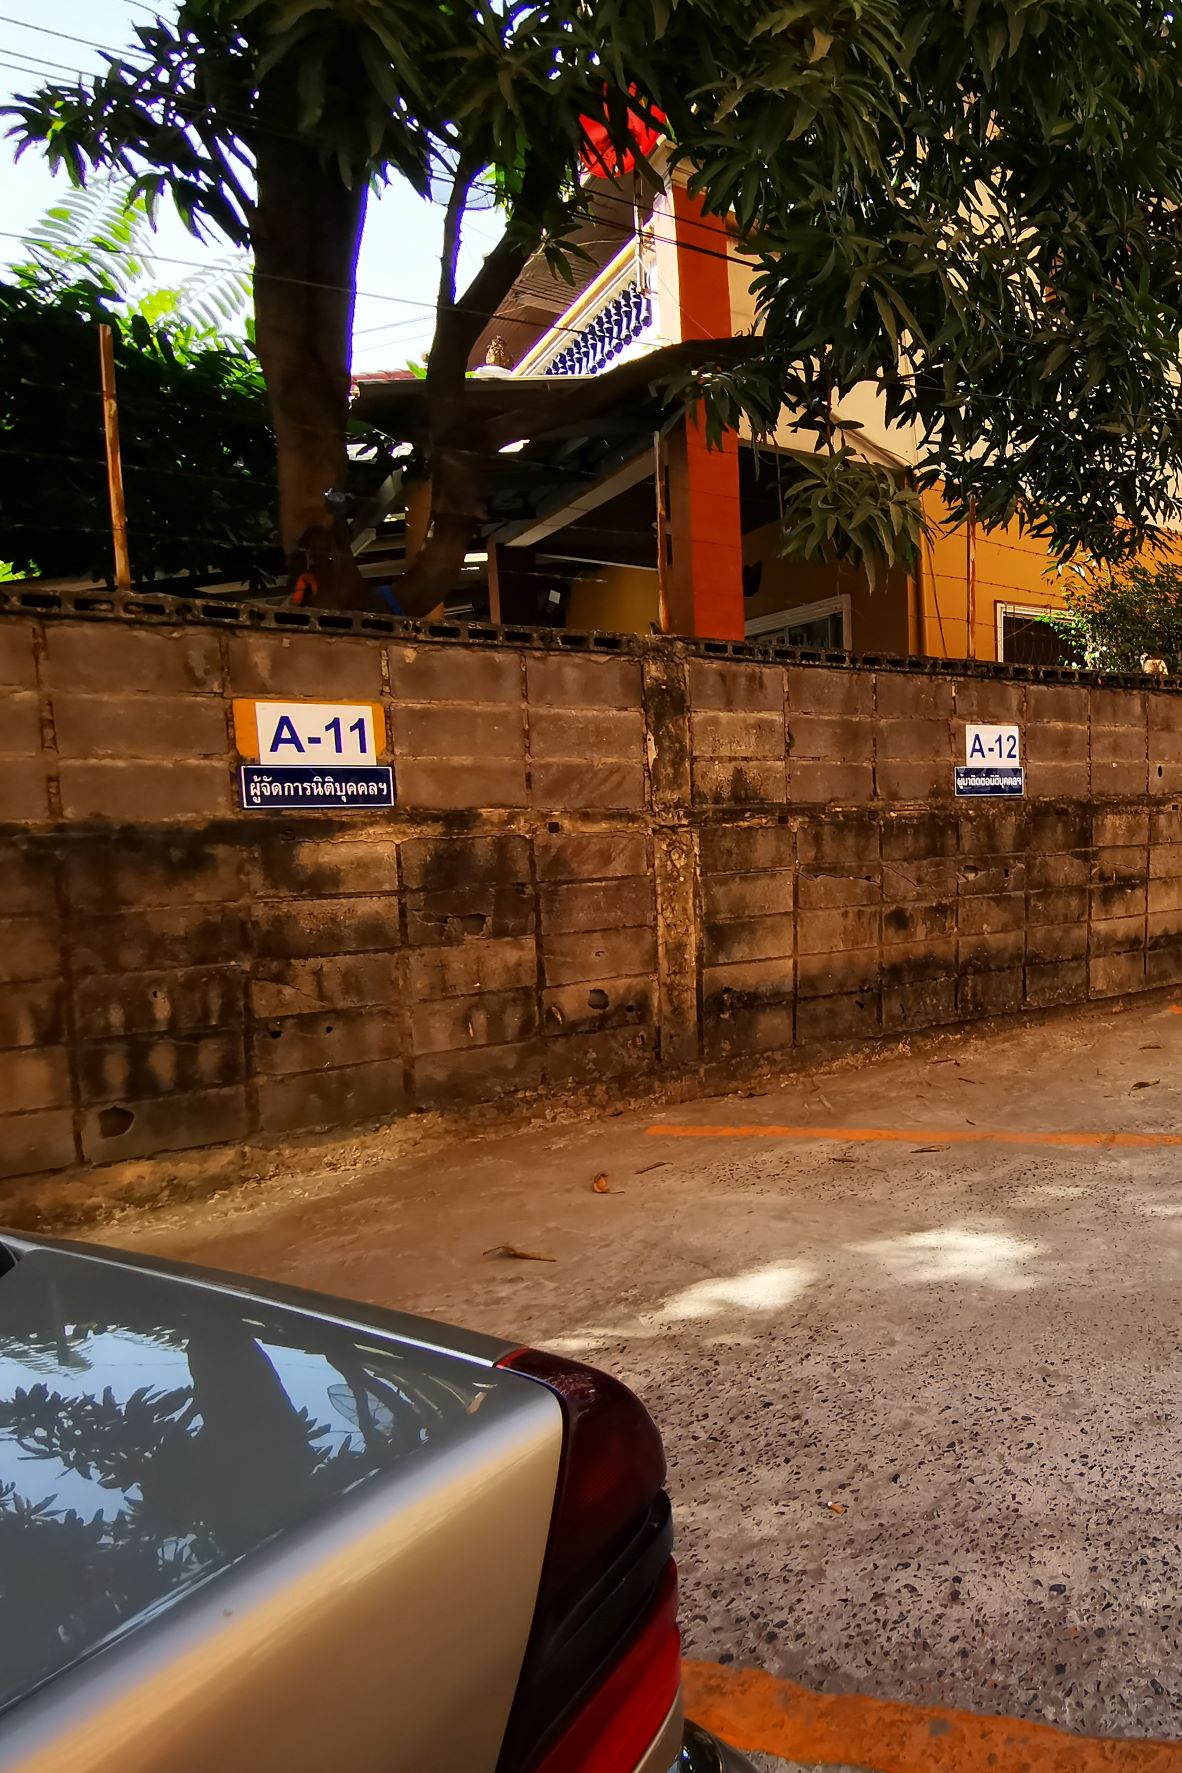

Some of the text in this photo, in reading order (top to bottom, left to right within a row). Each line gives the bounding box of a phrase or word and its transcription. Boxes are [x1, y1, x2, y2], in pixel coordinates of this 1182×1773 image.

[269, 715, 367, 754] A-11
[969, 734, 1016, 758] A-12
[250, 775, 387, 803] ผู้จัดการนิติบุคคลฯ
